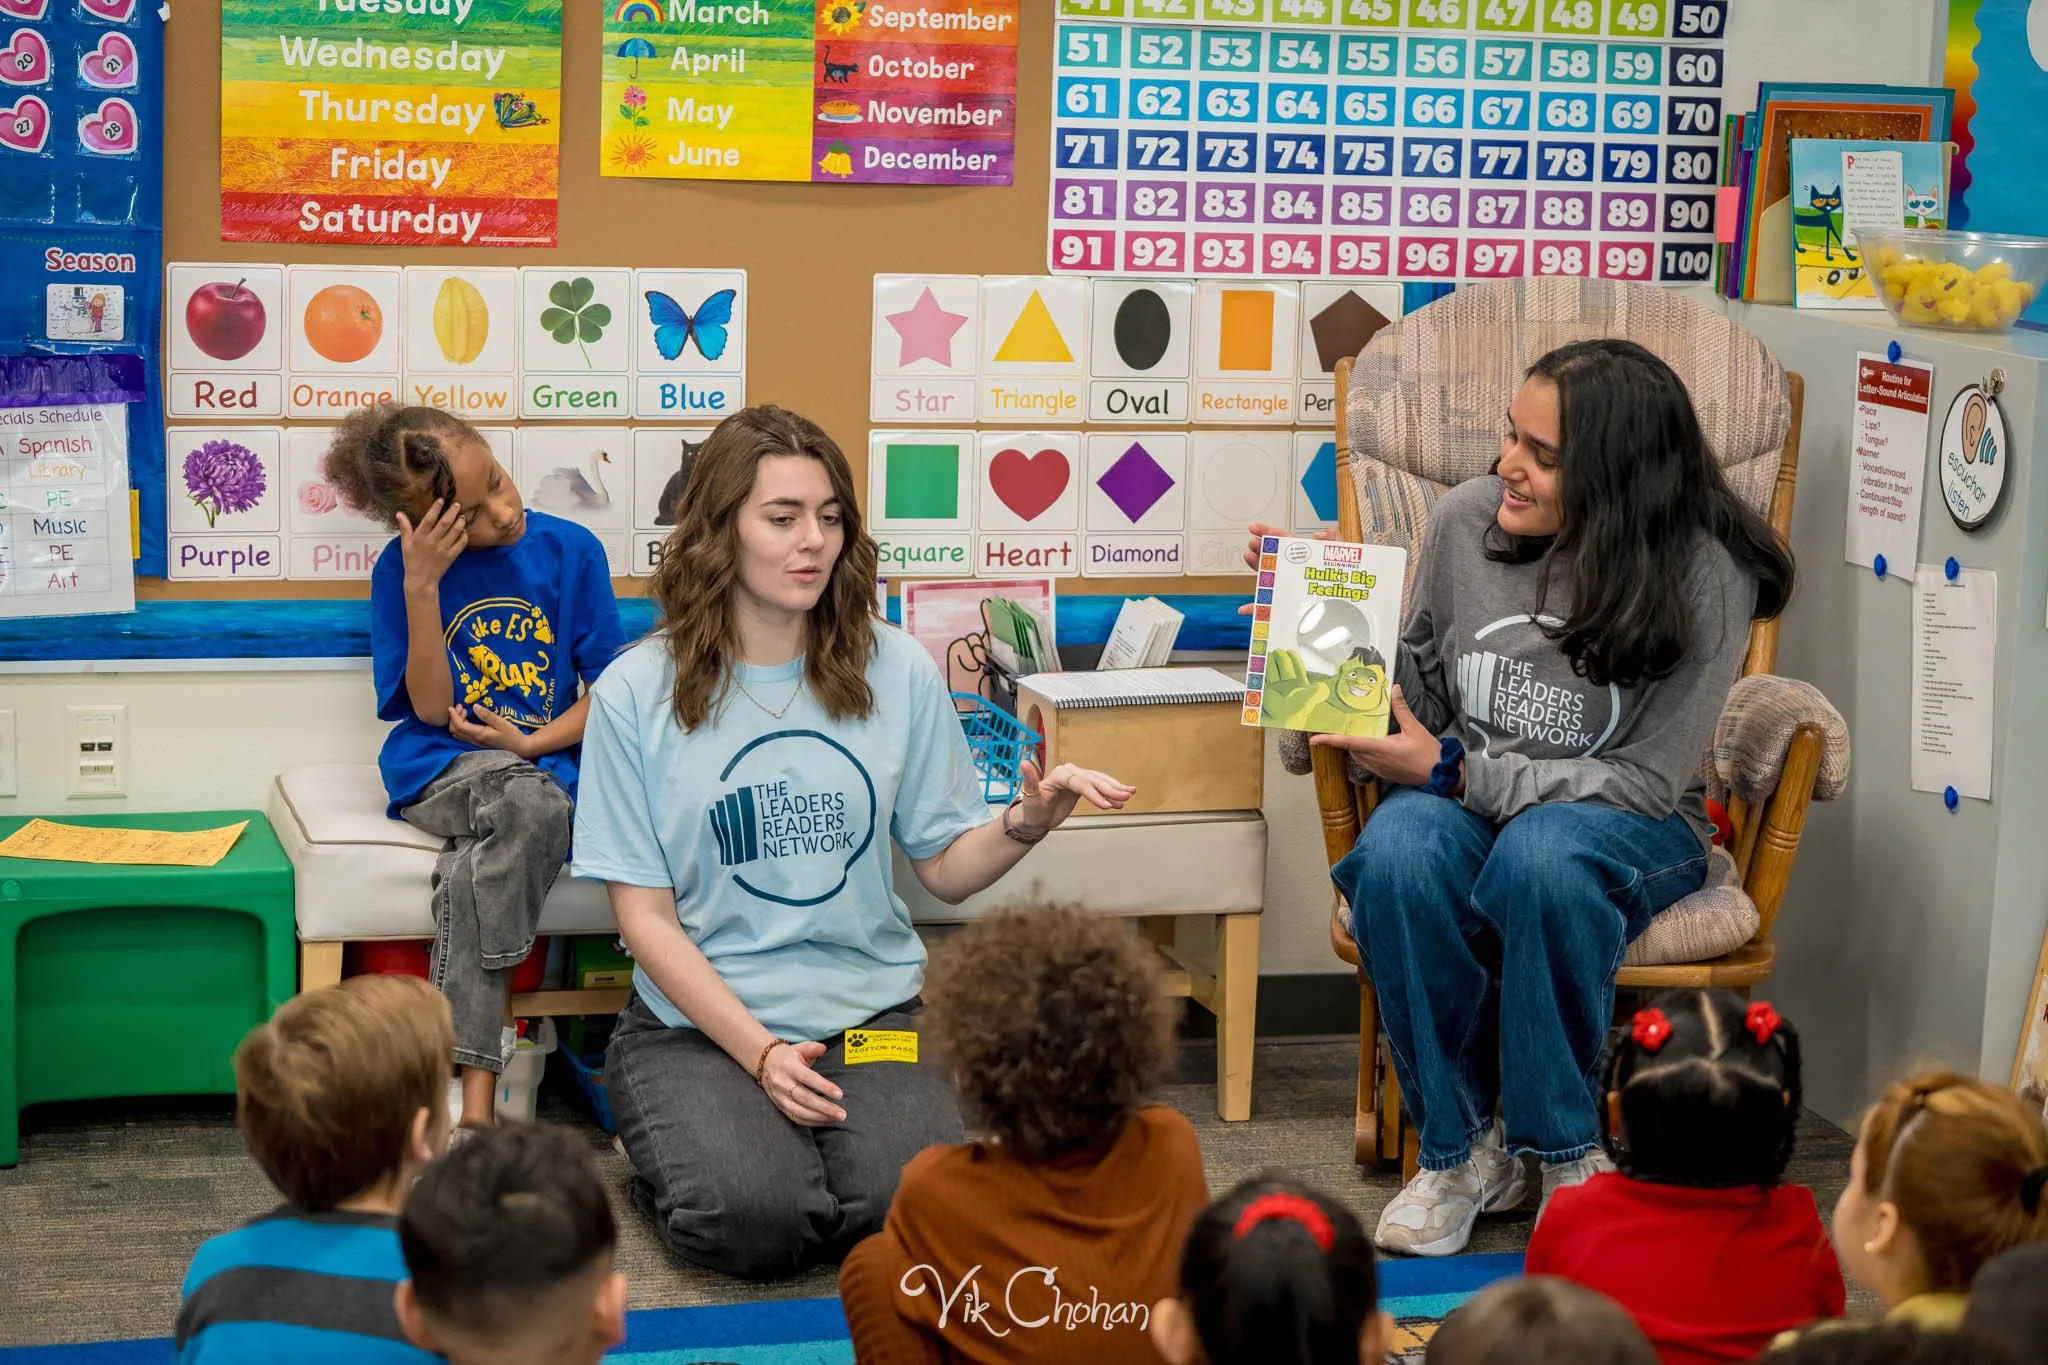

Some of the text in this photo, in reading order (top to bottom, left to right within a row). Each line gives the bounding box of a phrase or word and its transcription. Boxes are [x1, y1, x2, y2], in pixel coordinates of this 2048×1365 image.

[668, 0, 769, 26] March
[868, 7, 1012, 32] September
[1349, 0, 1392, 20] 45
[1417, 0, 1460, 24] 46
[1484, 0, 1528, 25] 47
[1551, 0, 1593, 29] 48
[1617, 3, 1658, 31] 49
[1680, 5, 1719, 33] 50
[17, 53, 33, 71] 20
[106, 58, 121, 72] 21
[280, 35, 505, 81] Wednesday
[670, 47, 745, 77] April
[868, 54, 974, 81] October
[1067, 33, 1716, 82] 51 52 53 54 55 56 57 58 59 60
[299, 90, 486, 131] Thursday
[667, 97, 733, 130] May
[867, 100, 1002, 126] November
[1066, 84, 1713, 131] 61 62 63 64 65 66 67 68 69 70
[16, 119, 31, 134] 27
[105, 122, 121, 139] 28
[668, 141, 740, 168] June
[864, 146, 997, 172] December
[1065, 135, 1711, 180] 71 72 73 74 75 76 77 78 79 80
[331, 148, 451, 190] Friday
[1063, 186, 1709, 228] 81 82 83 84 85 86 87 88 89 90
[299, 201, 482, 243] Saturday
[46, 247, 135, 273] Season
[1061, 236, 1709, 275] 91 92 93 94 95 96 97 98 99 100
[1859, 382, 1897, 398] Letter-Sound
[1882, 371, 1912, 386] Routine for
[193, 379, 258, 411] Red
[293, 383, 392, 414] Orange
[414, 384, 508, 411] Yellow
[532, 384, 618, 411] Green
[660, 384, 726, 411] Blue
[895, 388, 955, 413] Star
[991, 388, 1077, 416] Triangle
[1105, 388, 1170, 415] Oval
[1201, 393, 1289, 416] Rectangle
[40, 408, 103, 424] Schedule
[1865, 420, 1880, 431] Lips?
[19, 435, 92, 459] Spanish
[29, 464, 86, 481] Library
[1947, 451, 1986, 504] escuchar
[47, 490, 72, 507] PE
[1947, 480, 1970, 521] listen
[33, 518, 87, 535] Music
[49, 544, 73, 561] PE
[181, 543, 270, 575] Purple
[312, 543, 379, 572] Pink
[878, 541, 964, 570] Square
[986, 541, 1073, 568] Heart
[1091, 543, 1179, 564] Diamond
[1324, 546, 1361, 563] MARVEL
[48, 571, 78, 589] Art
[1304, 567, 1376, 588] Hulk's Big
[1308, 582, 1369, 602] Feelings
[505, 613, 534, 642] ES
[1499, 655, 1534, 678] THE
[1498, 673, 1584, 712] LEADERS
[1494, 692, 1583, 731] READERS
[1493, 711, 1594, 748] NETWORK
[755, 781, 788, 800] THE
[761, 792, 844, 820] LEADERS
[763, 812, 845, 839] READERS
[763, 831, 855, 859] NETWORK
[848, 1045, 914, 1054] VISITOR PASS
